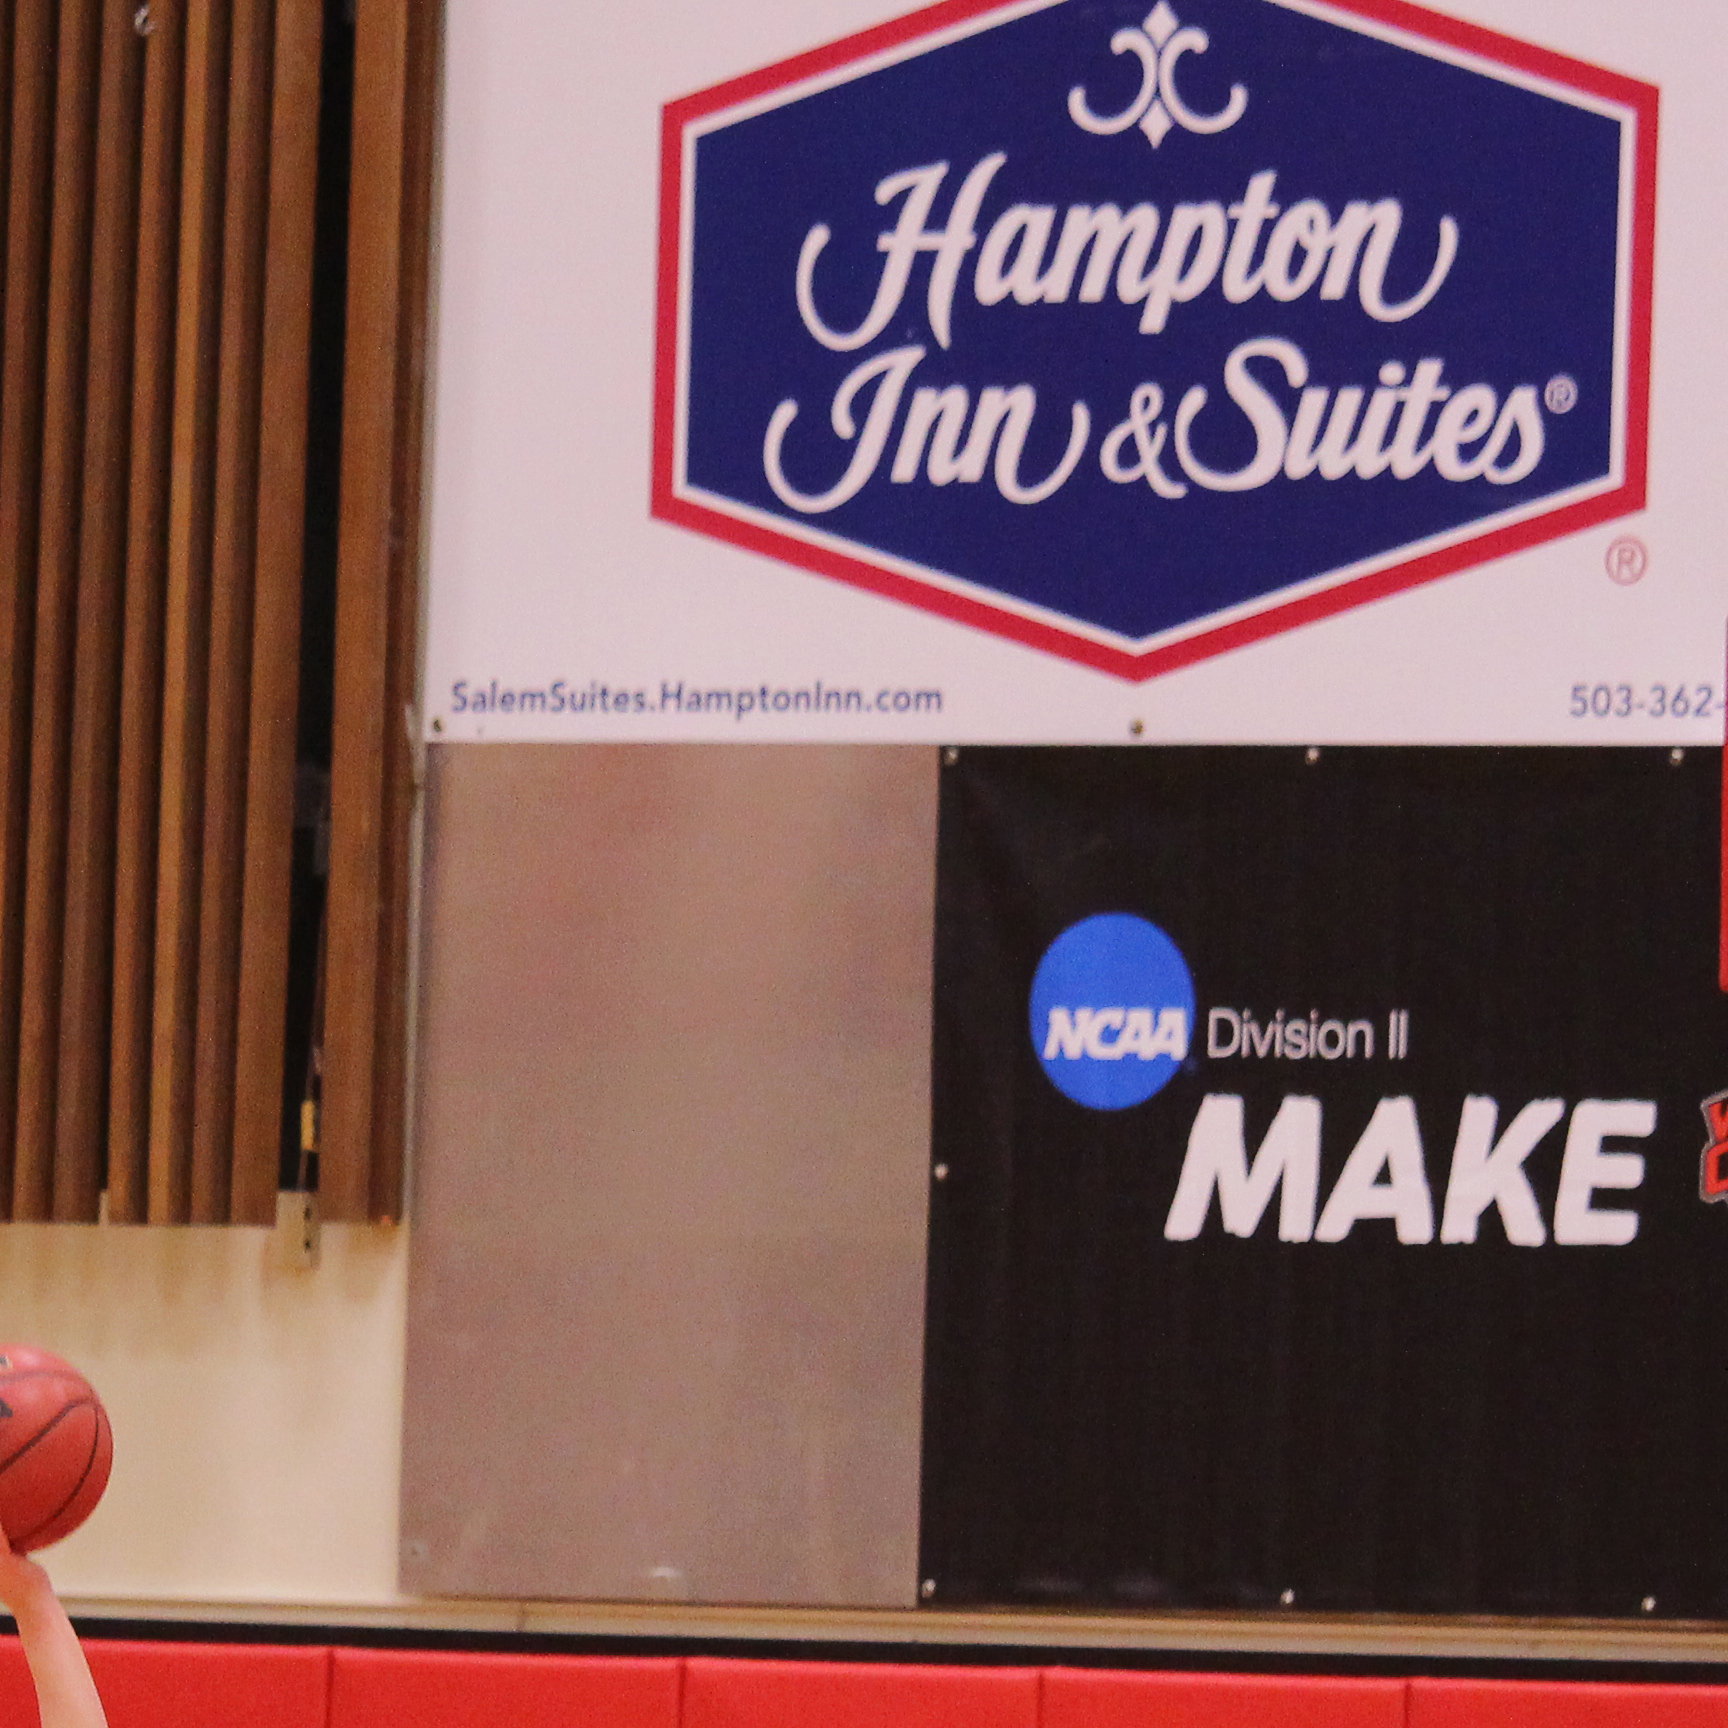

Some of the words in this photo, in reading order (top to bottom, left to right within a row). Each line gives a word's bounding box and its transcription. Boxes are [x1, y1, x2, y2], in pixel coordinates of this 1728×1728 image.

[796, 153, 1458, 352] Hampton
[764, 346, 1090, 514] Inn
[1100, 383, 1189, 500] &
[451, 681, 944, 722] SalemSuites.HamptonInn.com
[1570, 684, 1727, 718] 503-362-
[1044, 1007, 1189, 1061] NCAA
[1206, 1007, 1374, 1060] Division
[1387, 1008, 1409, 1060] II
[1164, 1094, 1657, 1247] MAKE
